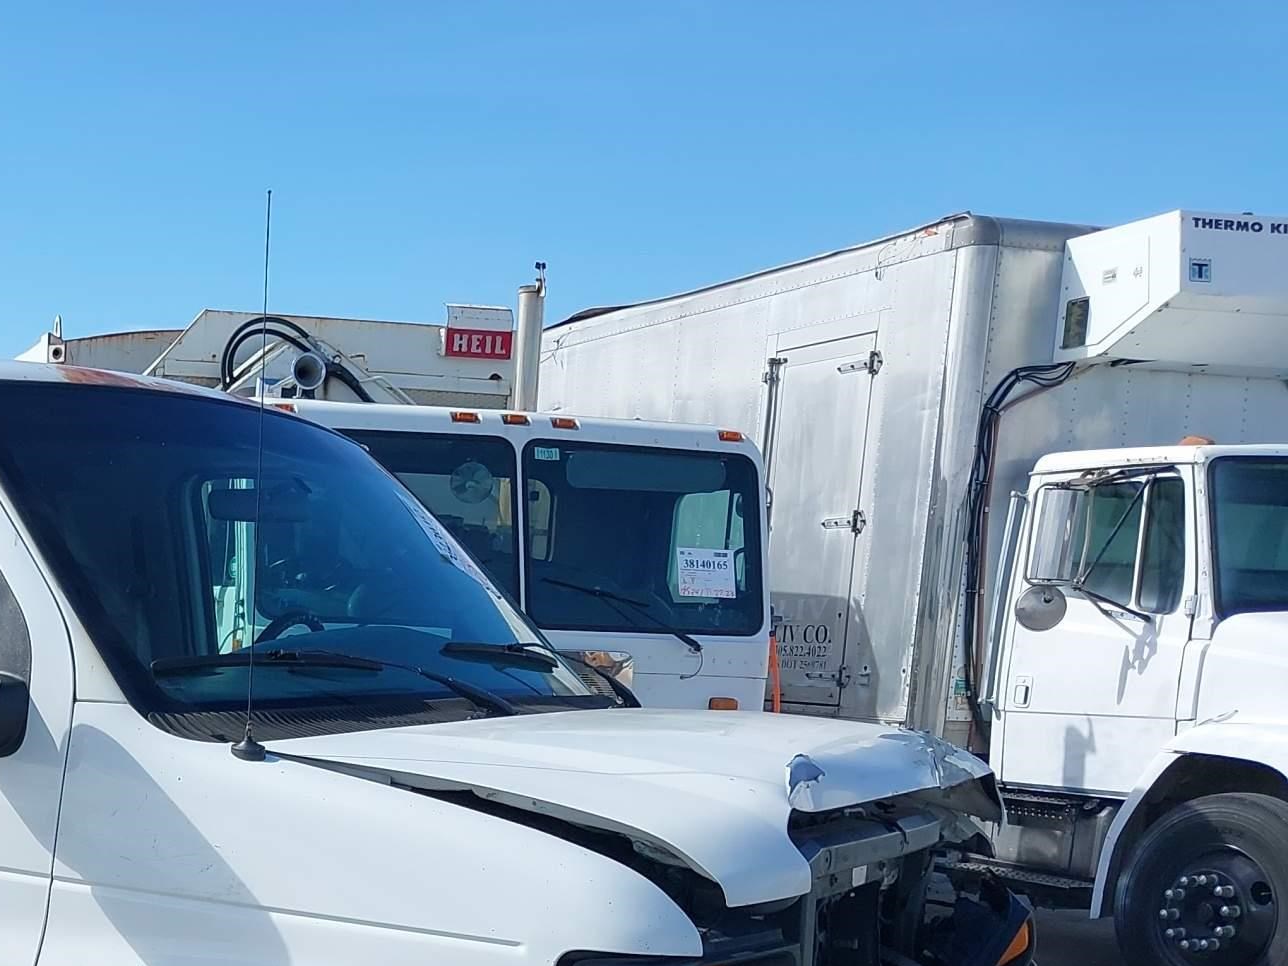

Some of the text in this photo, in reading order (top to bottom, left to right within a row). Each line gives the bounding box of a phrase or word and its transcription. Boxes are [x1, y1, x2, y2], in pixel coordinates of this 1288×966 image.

[1192, 217, 1263, 233] THERMO
[453, 333, 506, 354] HEIL
[683, 558, 729, 570] 38140165
[803, 625, 832, 643] CO.
